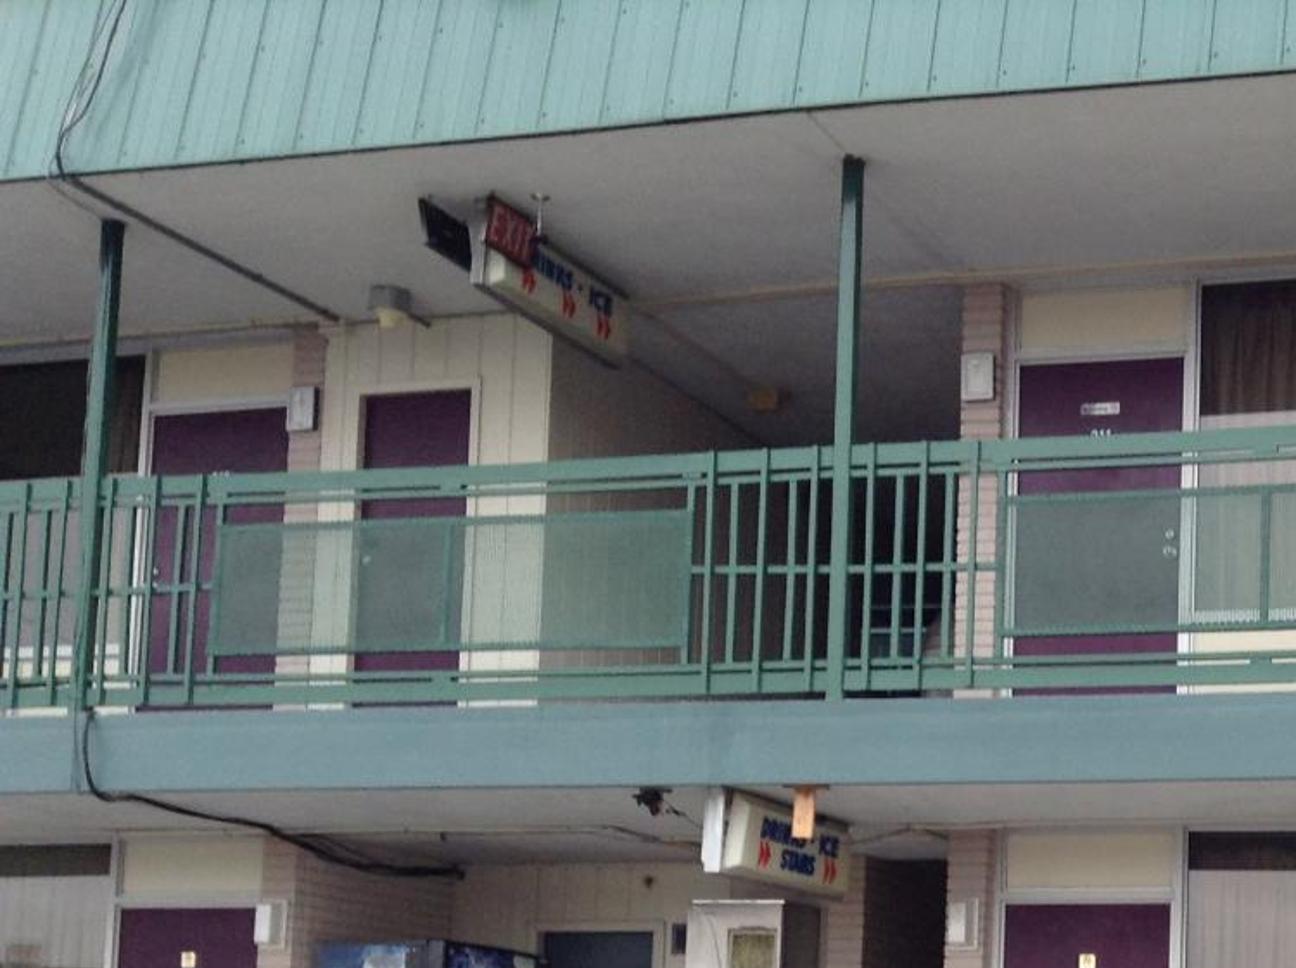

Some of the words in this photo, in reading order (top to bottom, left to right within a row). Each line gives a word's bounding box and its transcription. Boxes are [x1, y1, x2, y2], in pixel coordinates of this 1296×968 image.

[489, 203, 535, 261] EXIT
[589, 287, 613, 317] ICE
[819, 833, 840, 858] ICE
[780, 849, 816, 875] STAIRS
